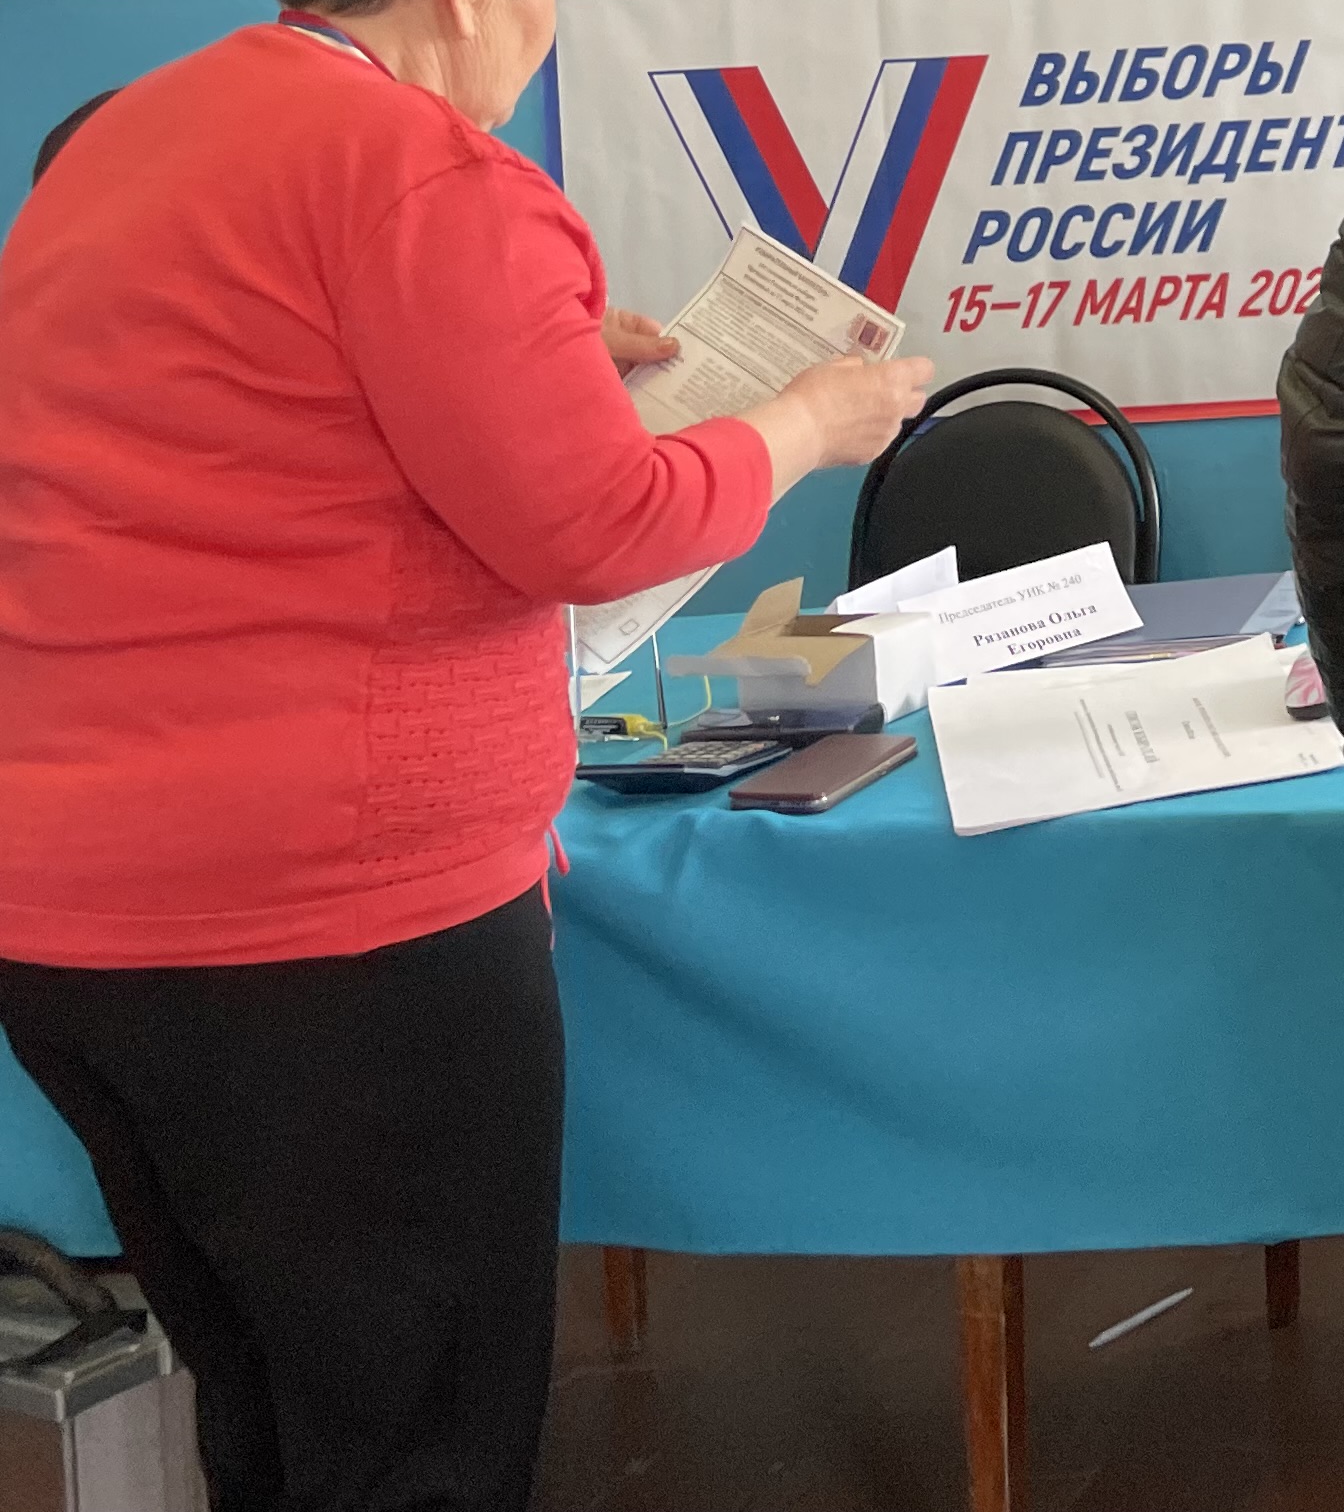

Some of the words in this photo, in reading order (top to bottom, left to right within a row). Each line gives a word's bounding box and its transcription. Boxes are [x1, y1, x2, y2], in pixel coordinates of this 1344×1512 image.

[1019, 39, 1312, 107] ВЫБОРЫ
[962, 198, 1227, 265] РОССИИ
[1073, 272, 1230, 326] МАРТА
[1238, 266, 1325, 318] 202
[938, 595, 1016, 625] Председатель
[1017, 585, 1046, 602] УИК
[1063, 574, 1082, 590] 240
[973, 619, 1046, 647] Рязанова
[1048, 603, 1098, 626] Ольга
[1007, 627, 1082, 656] Егоровна
